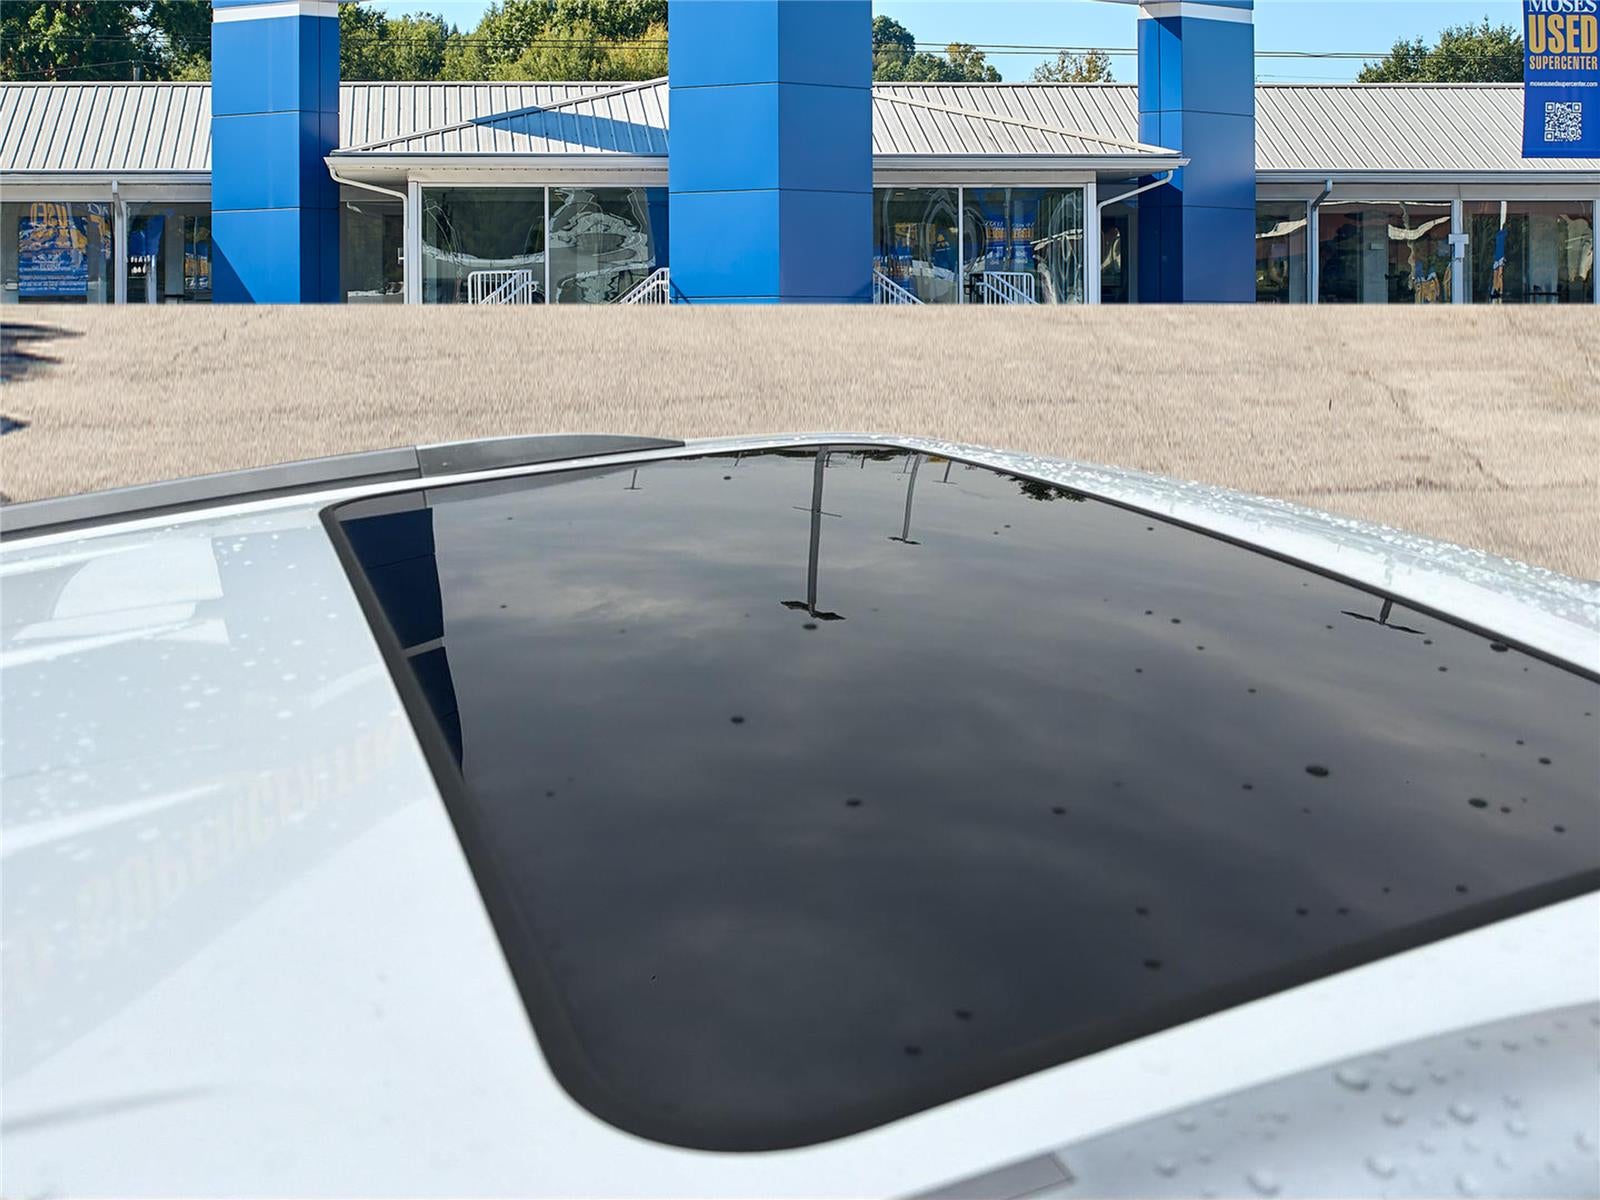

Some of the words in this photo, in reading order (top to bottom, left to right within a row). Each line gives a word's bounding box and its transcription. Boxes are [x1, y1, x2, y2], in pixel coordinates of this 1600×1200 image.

[1528, 0, 1597, 13] MOSES
[1528, 14, 1599, 54] USED
[1529, 55, 1598, 70] SUPERCENTER
